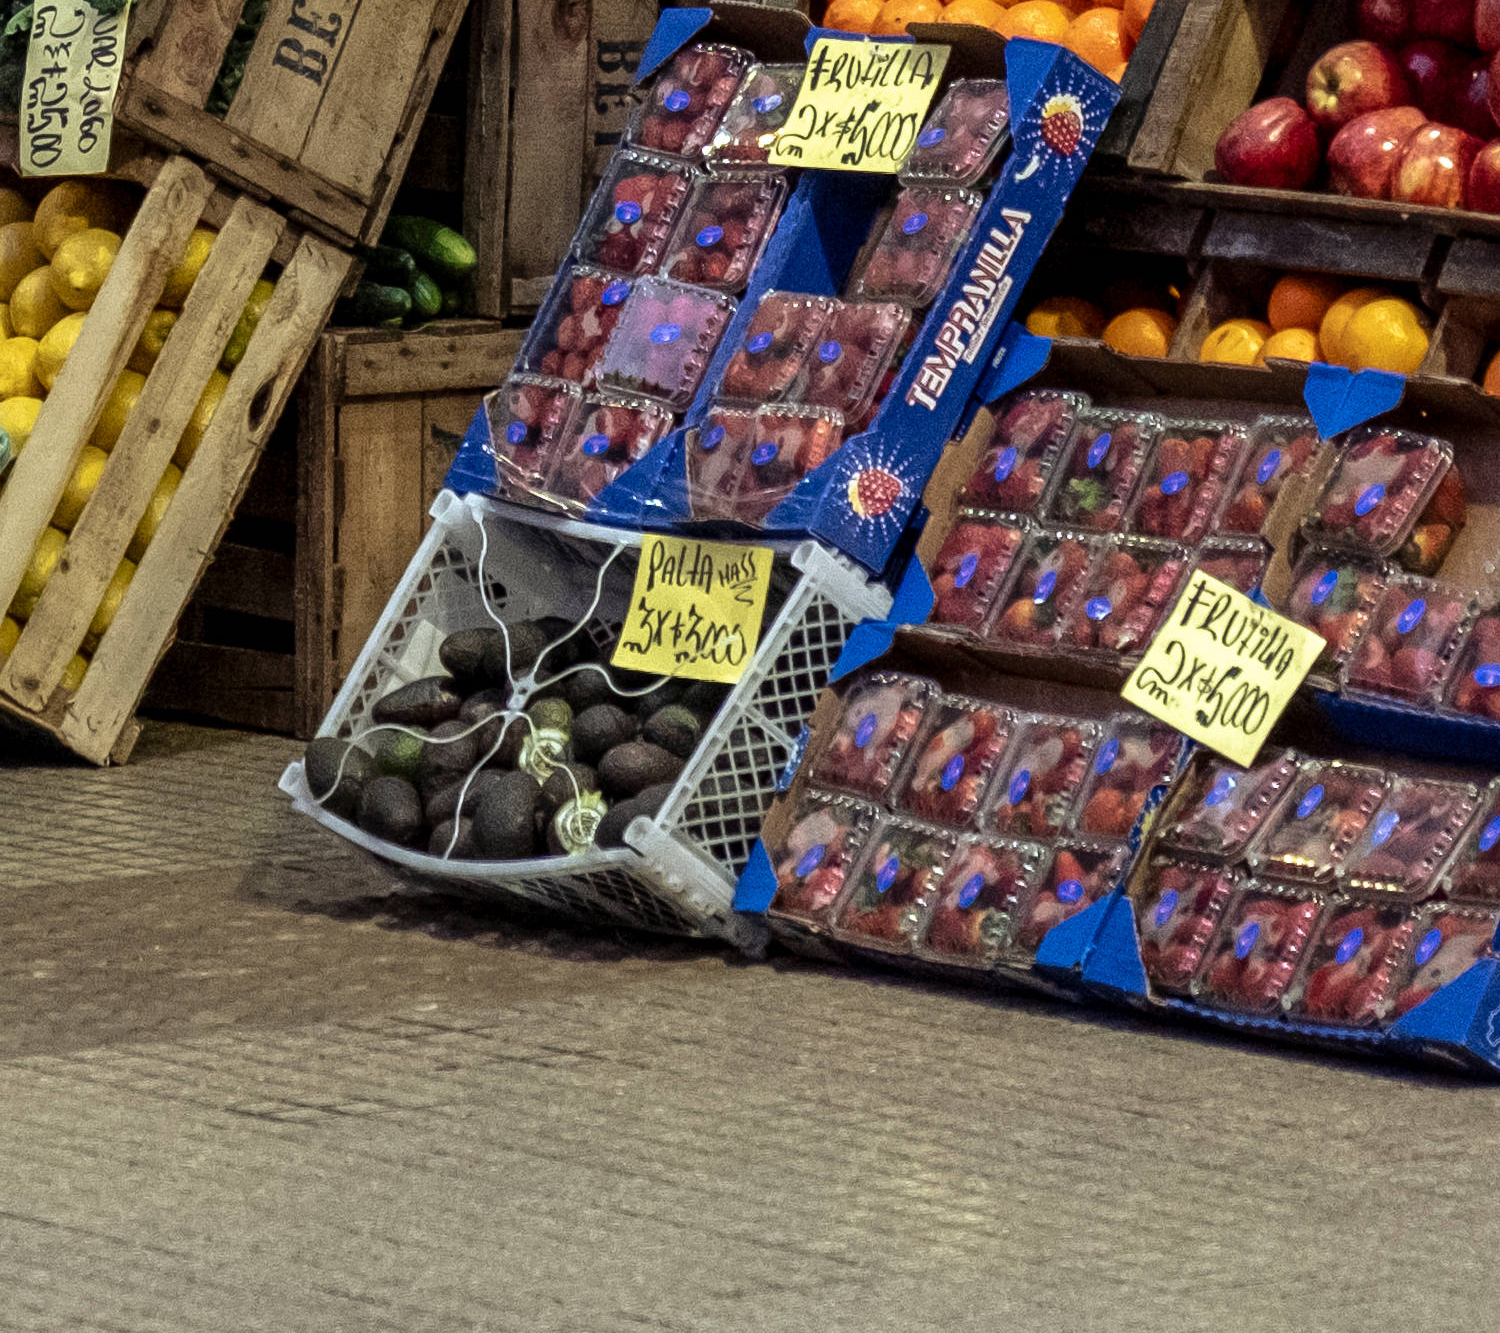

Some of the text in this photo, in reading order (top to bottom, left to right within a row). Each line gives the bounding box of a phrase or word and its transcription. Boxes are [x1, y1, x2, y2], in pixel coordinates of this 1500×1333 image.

[810, 45, 936, 93] FRUTILLA
[904, 207, 1033, 412] TEMPRANILLA
[646, 539, 713, 594] PALTA
[1179, 580, 1296, 681] FRUTILLA
